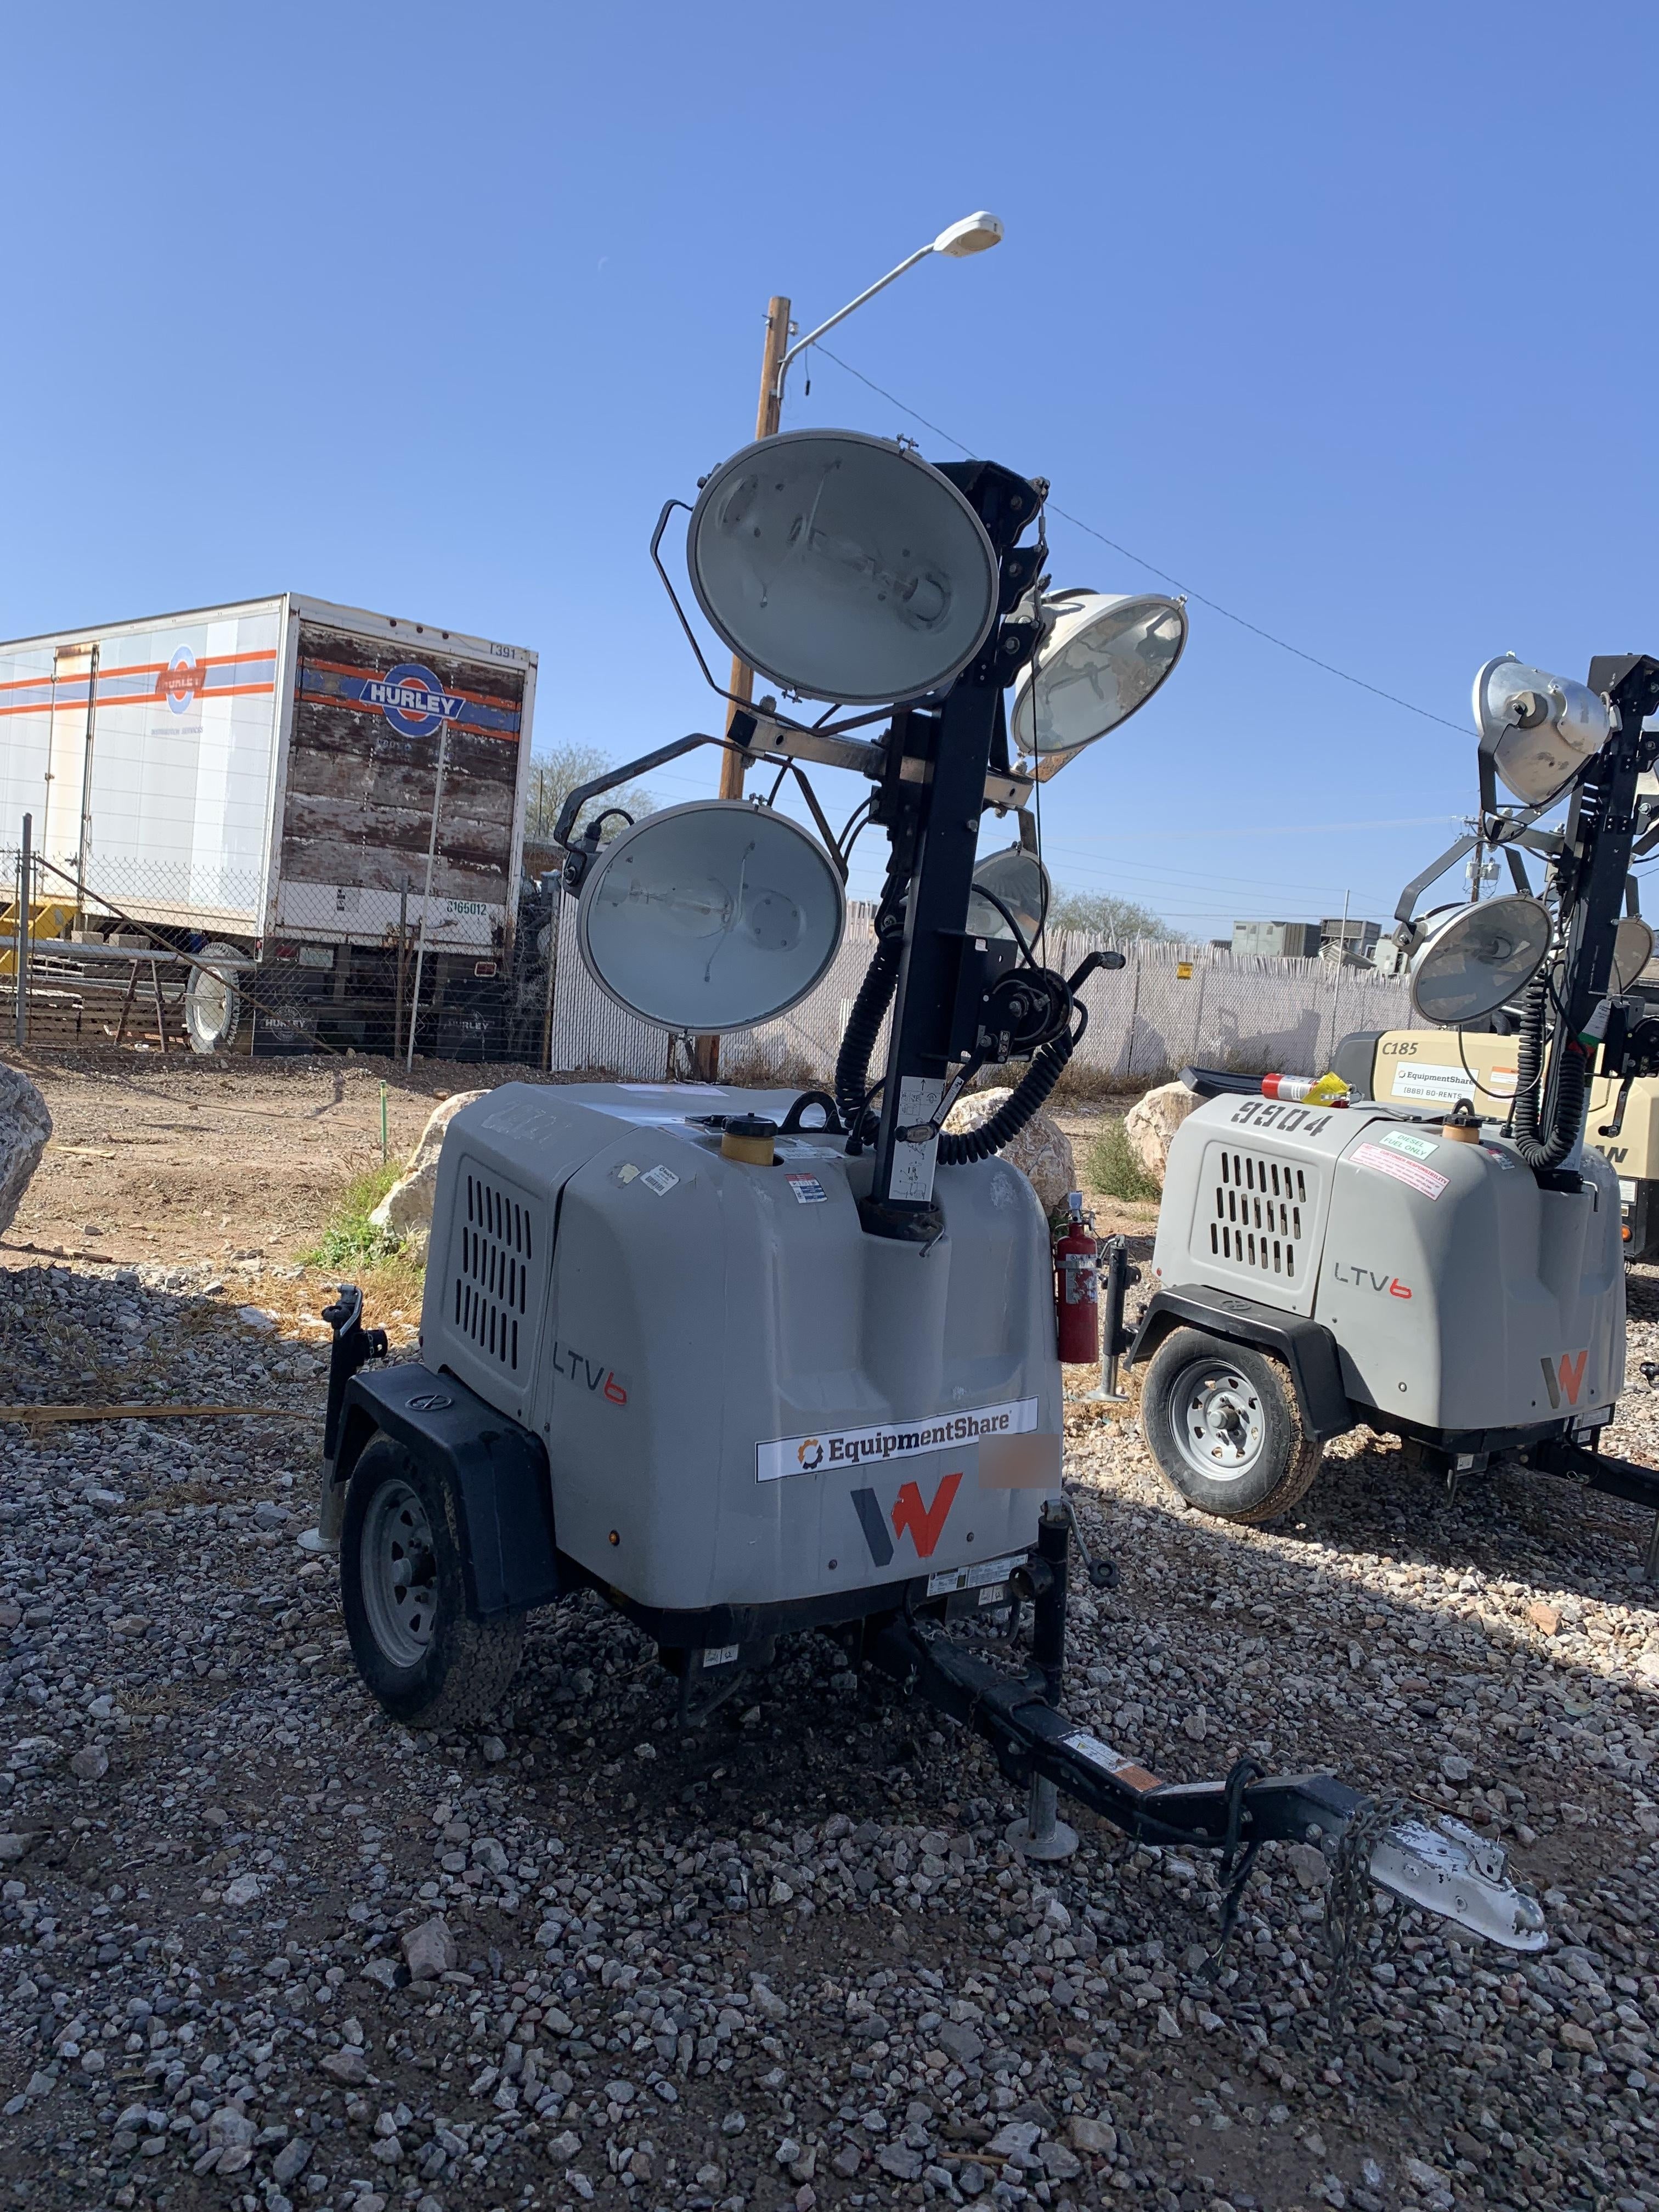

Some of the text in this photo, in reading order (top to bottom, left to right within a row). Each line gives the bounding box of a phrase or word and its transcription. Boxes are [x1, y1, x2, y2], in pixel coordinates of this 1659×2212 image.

[371, 684, 455, 715] HURLEY
[1382, 1042, 1419, 1056] C185
[1407, 1071, 1474, 1085] EquipmentShare
[1404, 1087, 1424, 1095] (888)
[1231, 1102, 1333, 1137] 9904
[1384, 1137, 1403, 1148] FUEL
[1404, 1144, 1427, 1156] ONLY
[1397, 1135, 1425, 1148] DIESEL
[1406, 1160, 1447, 1183] RESPONSIBILITY
[1334, 1262, 1413, 1299] LTV6
[552, 1341, 627, 1406] LTV6
[828, 1413, 1009, 1463] EquipmentShare
